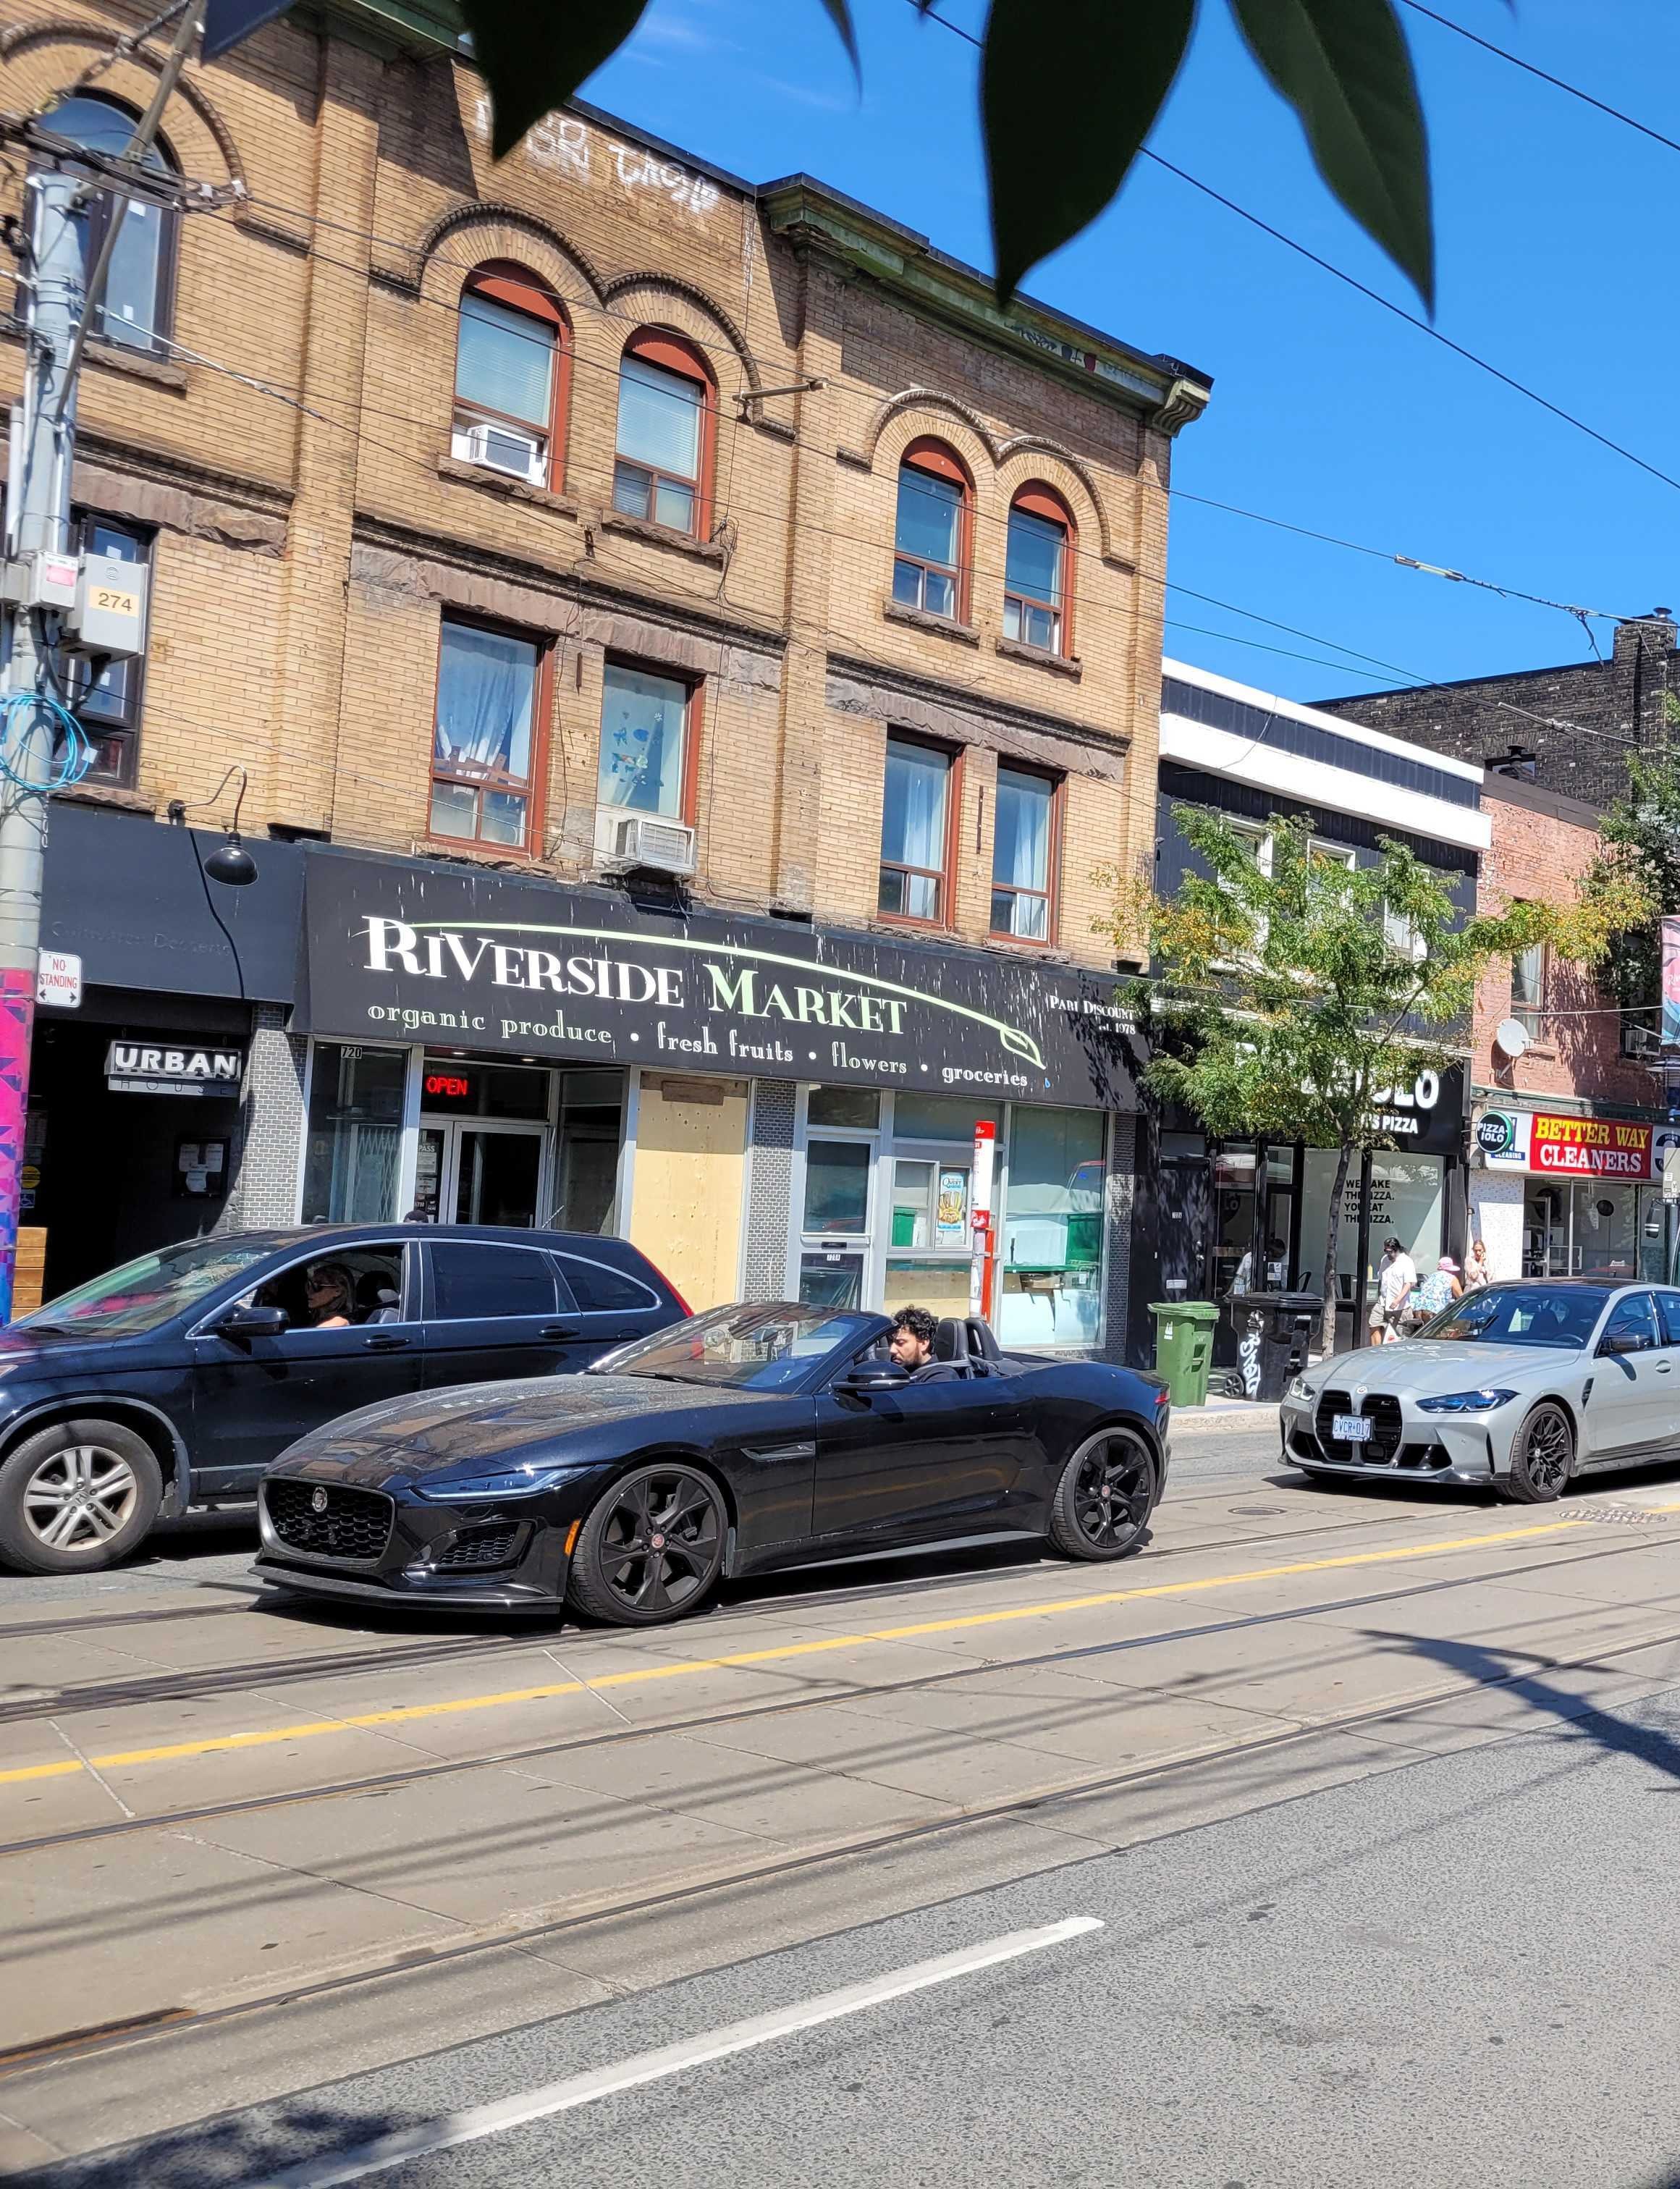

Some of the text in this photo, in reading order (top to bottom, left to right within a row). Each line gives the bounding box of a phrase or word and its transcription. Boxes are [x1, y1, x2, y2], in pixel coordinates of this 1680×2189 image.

[98, 592, 132, 612] 274
[53, 958, 67, 971] NO
[40, 973, 77, 989] STANDING
[362, 915, 908, 1034] RIVERSIDE MARKET
[1115, 1022, 1136, 1034] 1978
[342, 1047, 362, 1058] 720
[368, 1004, 1028, 1087] organic produce fresh fruits flowers groceries
[115, 1047, 237, 1078] URBAN
[121, 1079, 228, 1095] HOUSE
[426, 1076, 468, 1096] OPEN
[1383, 1115, 1419, 1134] PIZZA
[1481, 1132, 1504, 1142] IOLO
[1535, 1117, 1649, 1149] BETTER WAY
[1540, 1144, 1642, 1173] CLEANERS
[1346, 1180, 1390, 1189] WE AKE
[1370, 1191, 1395, 1200] IZZA.
[1369, 1202, 1384, 1212] AT
[1369, 1215, 1394, 1223] IZZA.
